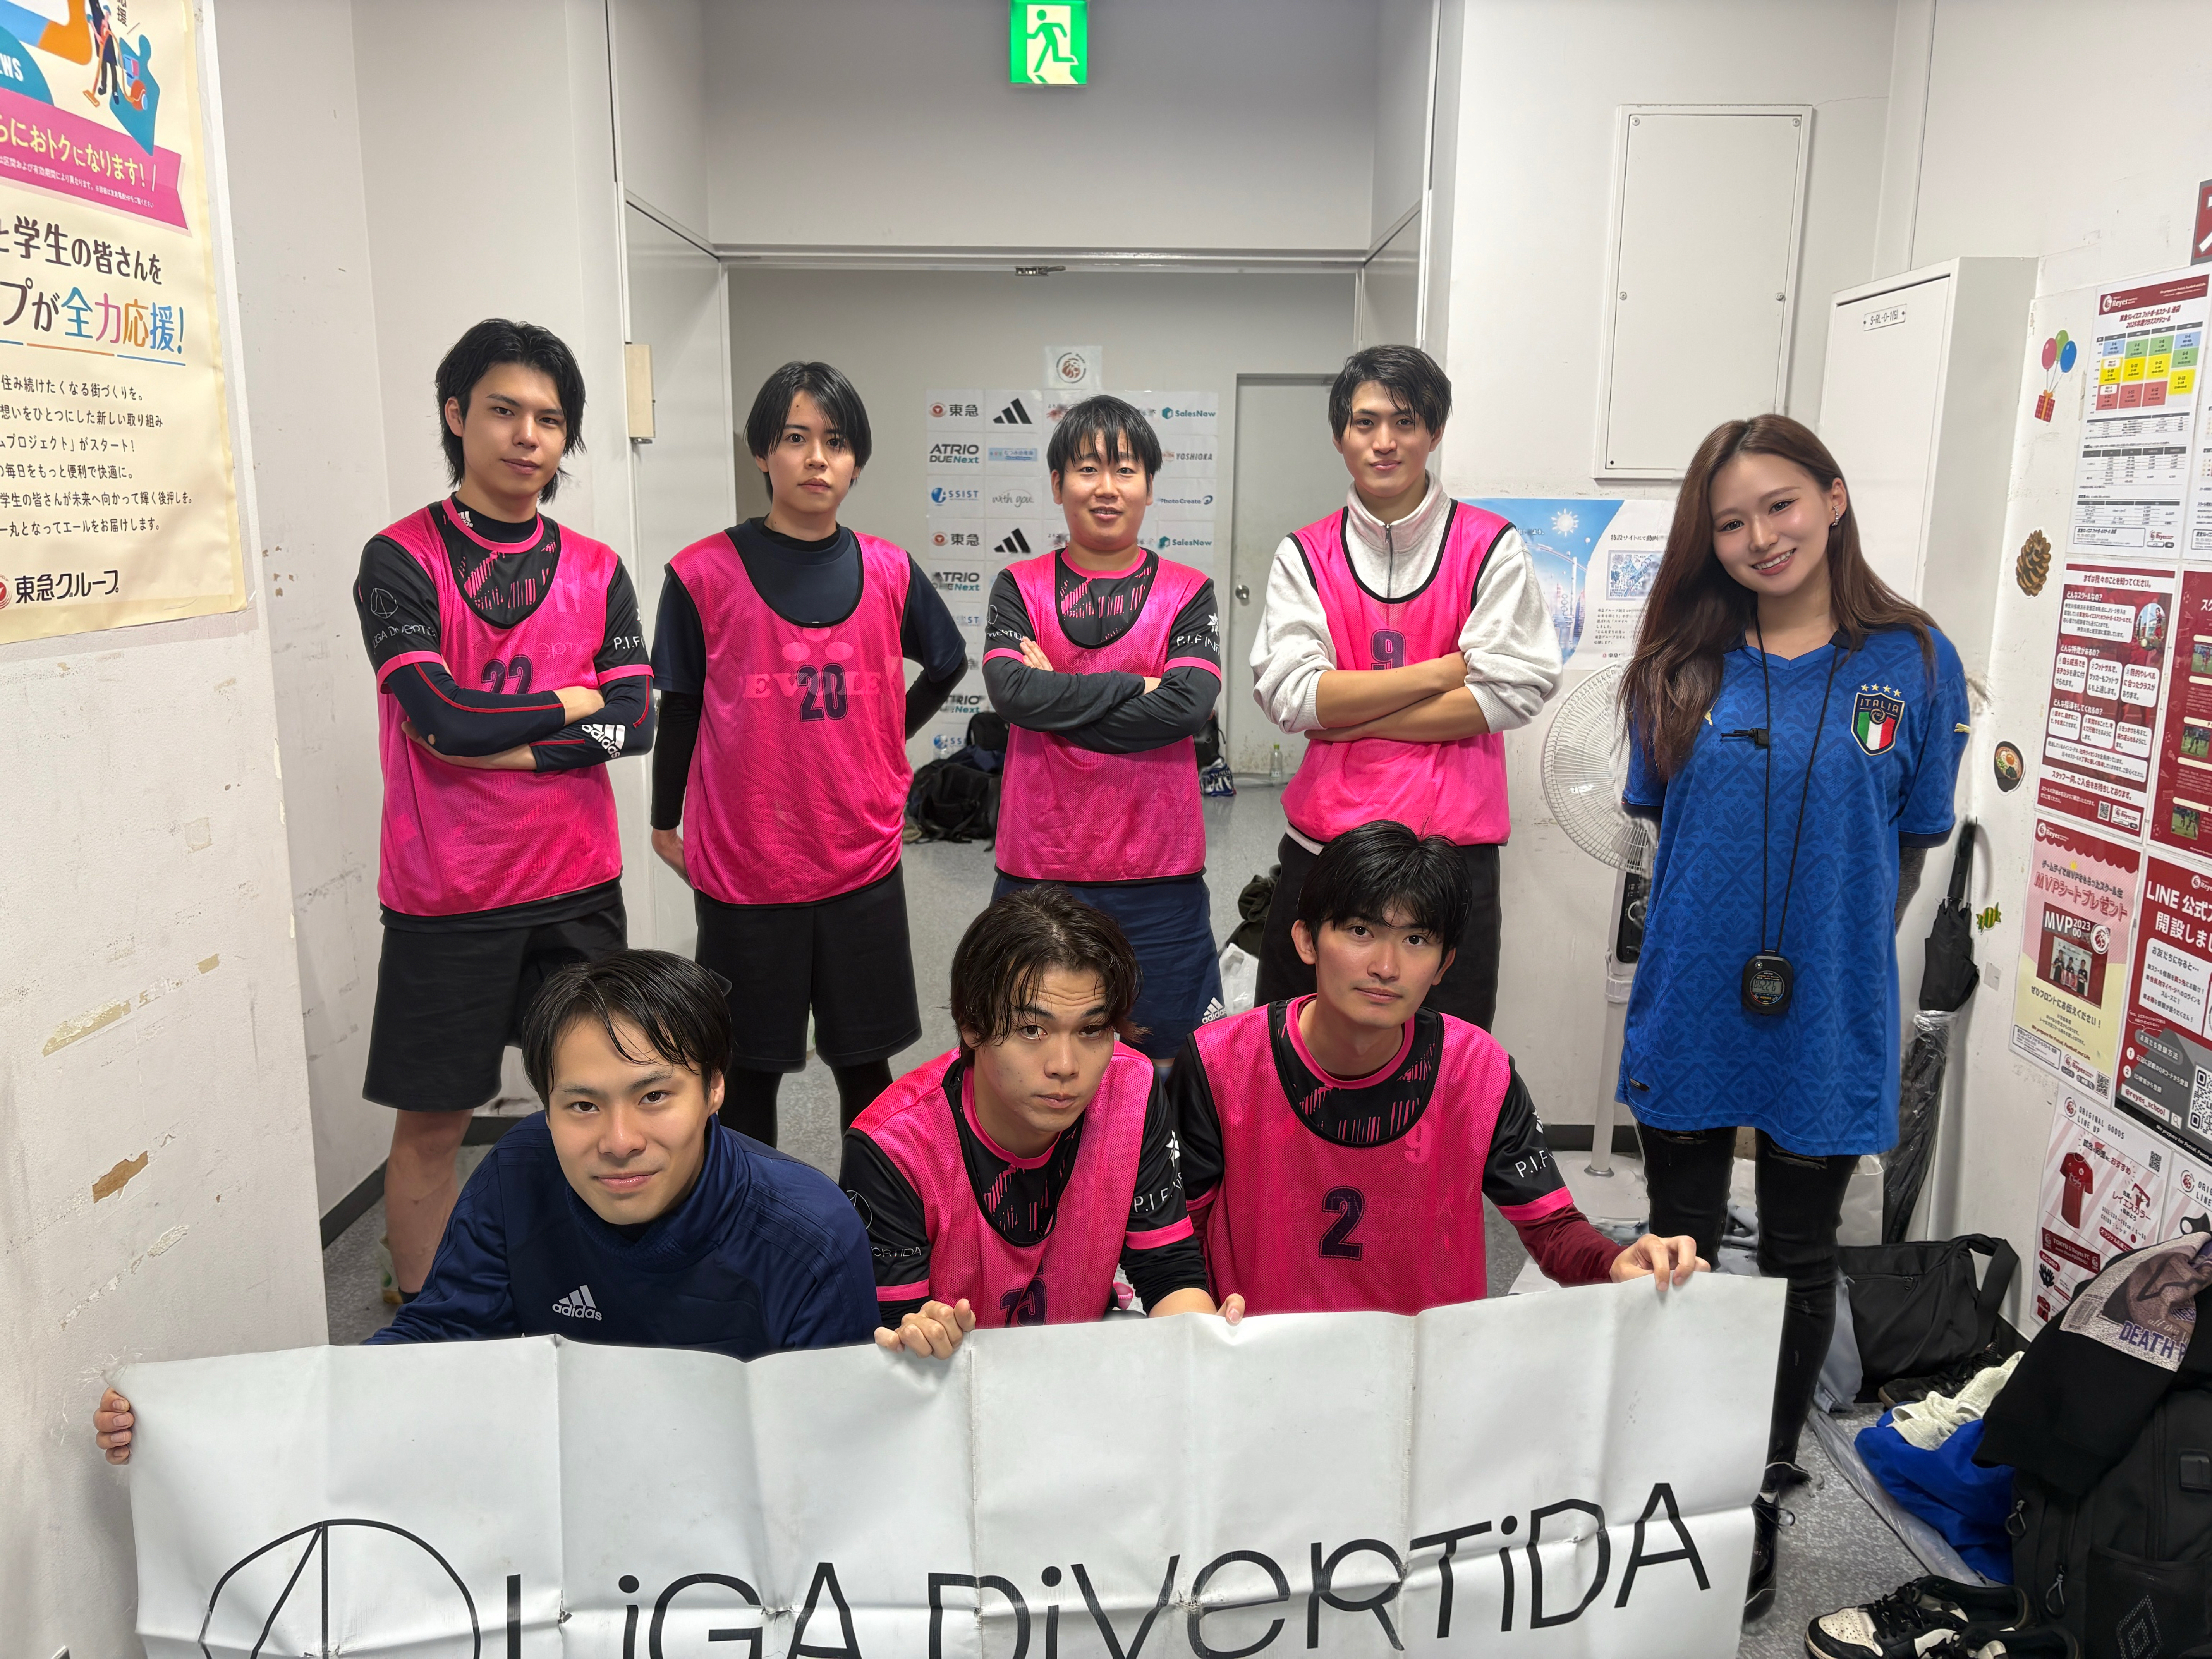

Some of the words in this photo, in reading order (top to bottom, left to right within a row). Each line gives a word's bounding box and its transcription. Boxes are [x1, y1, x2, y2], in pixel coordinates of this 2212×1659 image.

[0, 58, 24, 81] WS
[1, 374, 143, 401] 住み続けたくなる街づくりを。
[0, 404, 163, 428] 想いをひとつにした新しい取り組み
[949, 404, 979, 417] 東急
[930, 444, 979, 455] ATRIO
[0, 491, 192, 508] 学生の皆さんが未来へ向かって輝く後押しを。
[992, 493, 1013, 503] with
[0, 517, 160, 537] 一丸となってエールをお届けします。
[951, 534, 980, 546] 東急
[15, 570, 119, 604] 東急グループ
[2083, 575, 2151, 588] まずは我々のことを知ってください。
[2066, 591, 2103, 601] どんなスクールなの？
[1371, 629, 1407, 671] 9
[2060, 644, 2100, 656] どんな特徴があるの？
[2056, 678, 2073, 688] けられます。
[2089, 673, 2119, 684] サッカーもフットサ
[2124, 679, 2155, 691] に合ったクラスが
[797, 663, 848, 722] 20
[2122, 690, 2139, 700] あります。
[1860, 699, 1899, 713] ITALIA
[2053, 699, 2103, 715] どんな指導をしてくれるの？
[582, 725, 621, 758] adidas
[2051, 770, 2132, 800] スタッフ一同、ご入会をお待ちしております。
[2046, 829, 2060, 839] Reyes
[2034, 871, 2128, 922] MVPシートプレゼント
[2146, 881, 2180, 909] LINE
[2045, 911, 2073, 934] MVP
[2073, 919, 2091, 931] 2023
[2073, 928, 2081, 938] 00
[2140, 1034, 2179, 1060] お友だち登録方法
[2125, 1089, 2165, 1116] @reyes_school
[2077, 1116, 2090, 1129] LINE
[2093, 1125, 2100, 1134] UP
[2079, 1106, 2104, 1127] ORIGINAL
[2108, 1124, 2125, 1139] GOODS
[2112, 1190, 2151, 1220] レイエスカラー
[1318, 1185, 1365, 1261] 2
[2053, 1238, 2068, 1250] TOKYU
[2072, 1246, 2084, 1257] Reyes
[2072, 1254, 2088, 1265] FOOTBALL
[552, 1302, 602, 1321] adidas
[2119, 1320, 2177, 1360] DEATH
